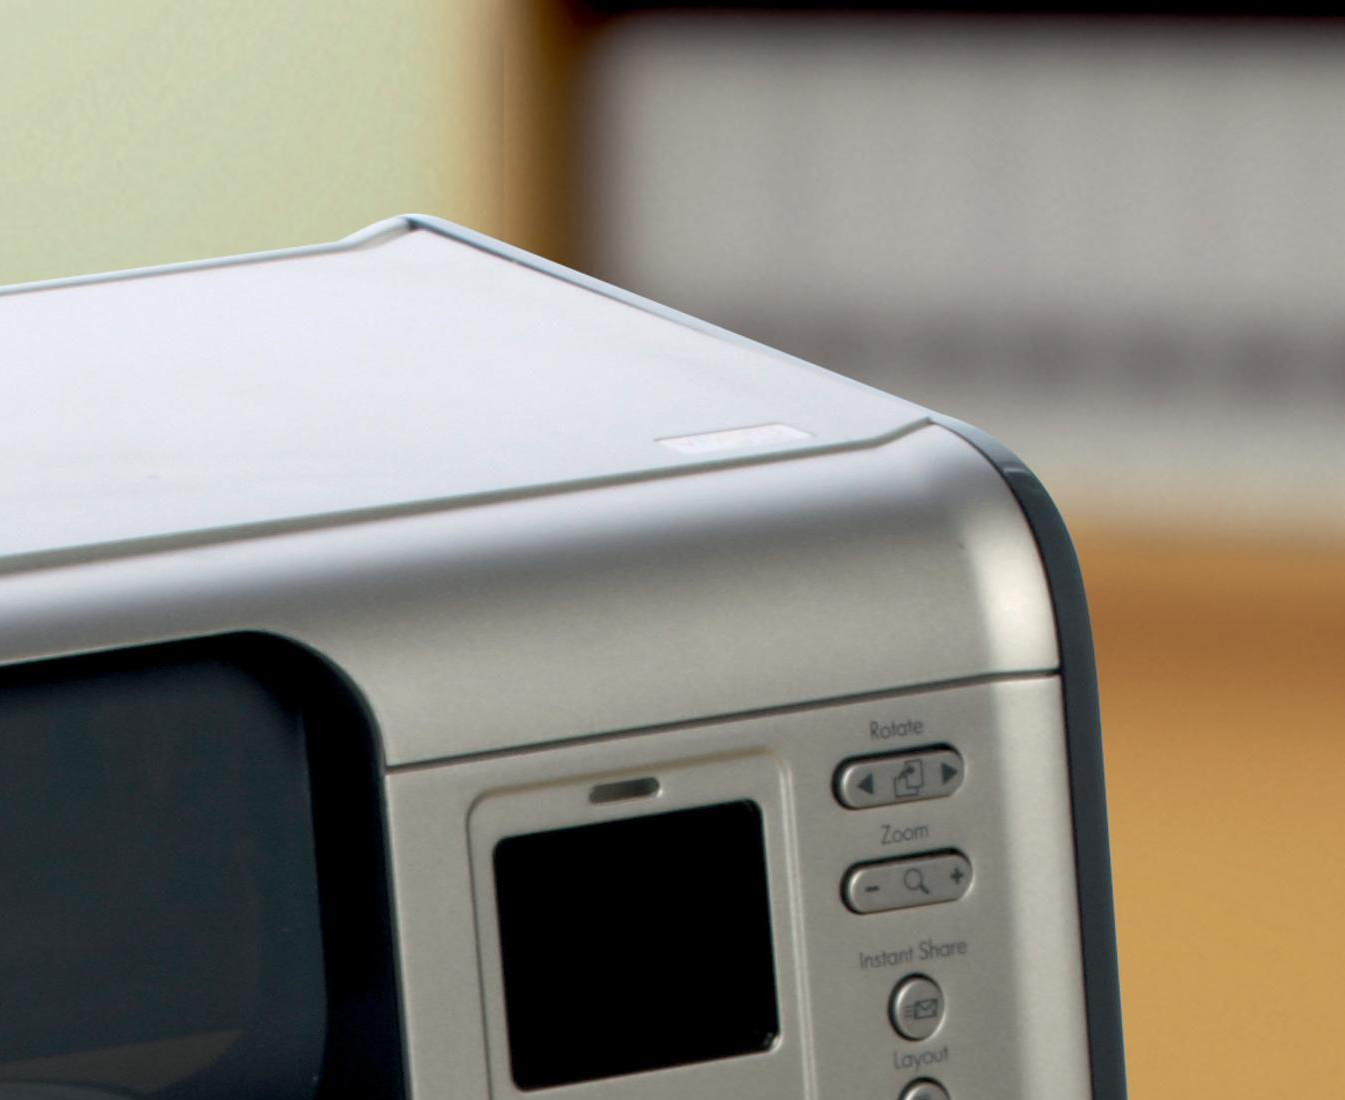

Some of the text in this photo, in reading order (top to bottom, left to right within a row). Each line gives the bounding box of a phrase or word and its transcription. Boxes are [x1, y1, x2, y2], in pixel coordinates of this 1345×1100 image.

[869, 718, 924, 740] Rotate
[881, 824, 930, 845] Zoom
[859, 938, 969, 970] Instant Share
[893, 1047, 950, 1072] Layout
